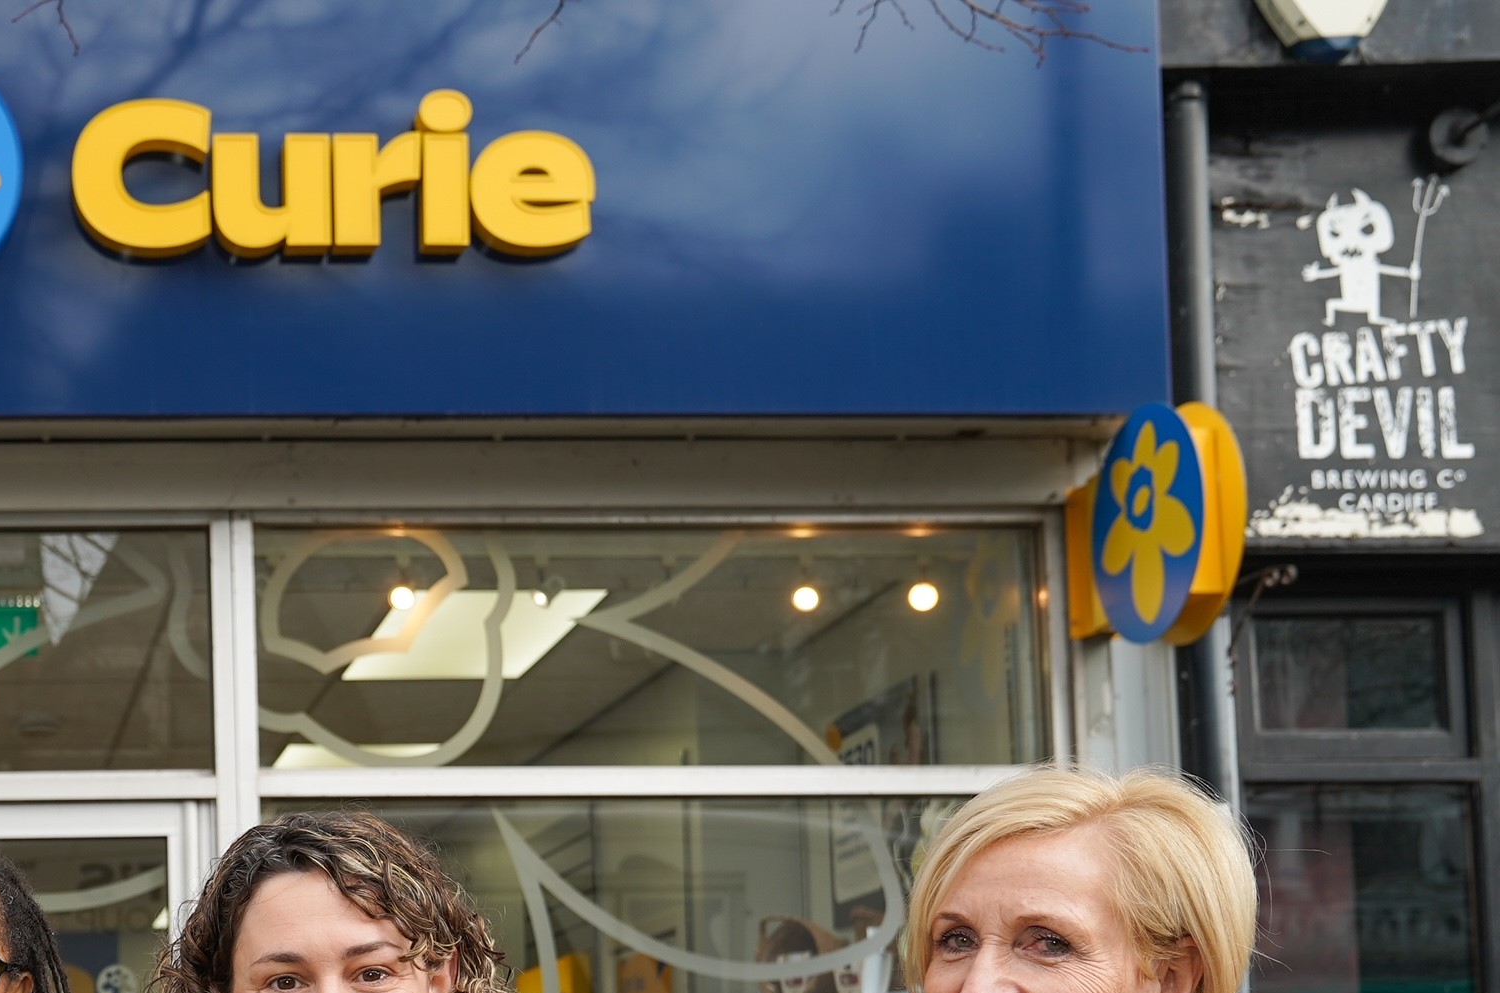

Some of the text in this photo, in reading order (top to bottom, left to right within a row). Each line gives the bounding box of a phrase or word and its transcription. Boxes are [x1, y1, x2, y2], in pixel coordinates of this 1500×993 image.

[71, 88, 597, 258] Curie
[1289, 317, 1469, 389] CRAFTY
[1293, 386, 1476, 461] DEVIL
[1310, 468, 1428, 490] BREWING
[1338, 491, 1439, 514] CARDIFF
